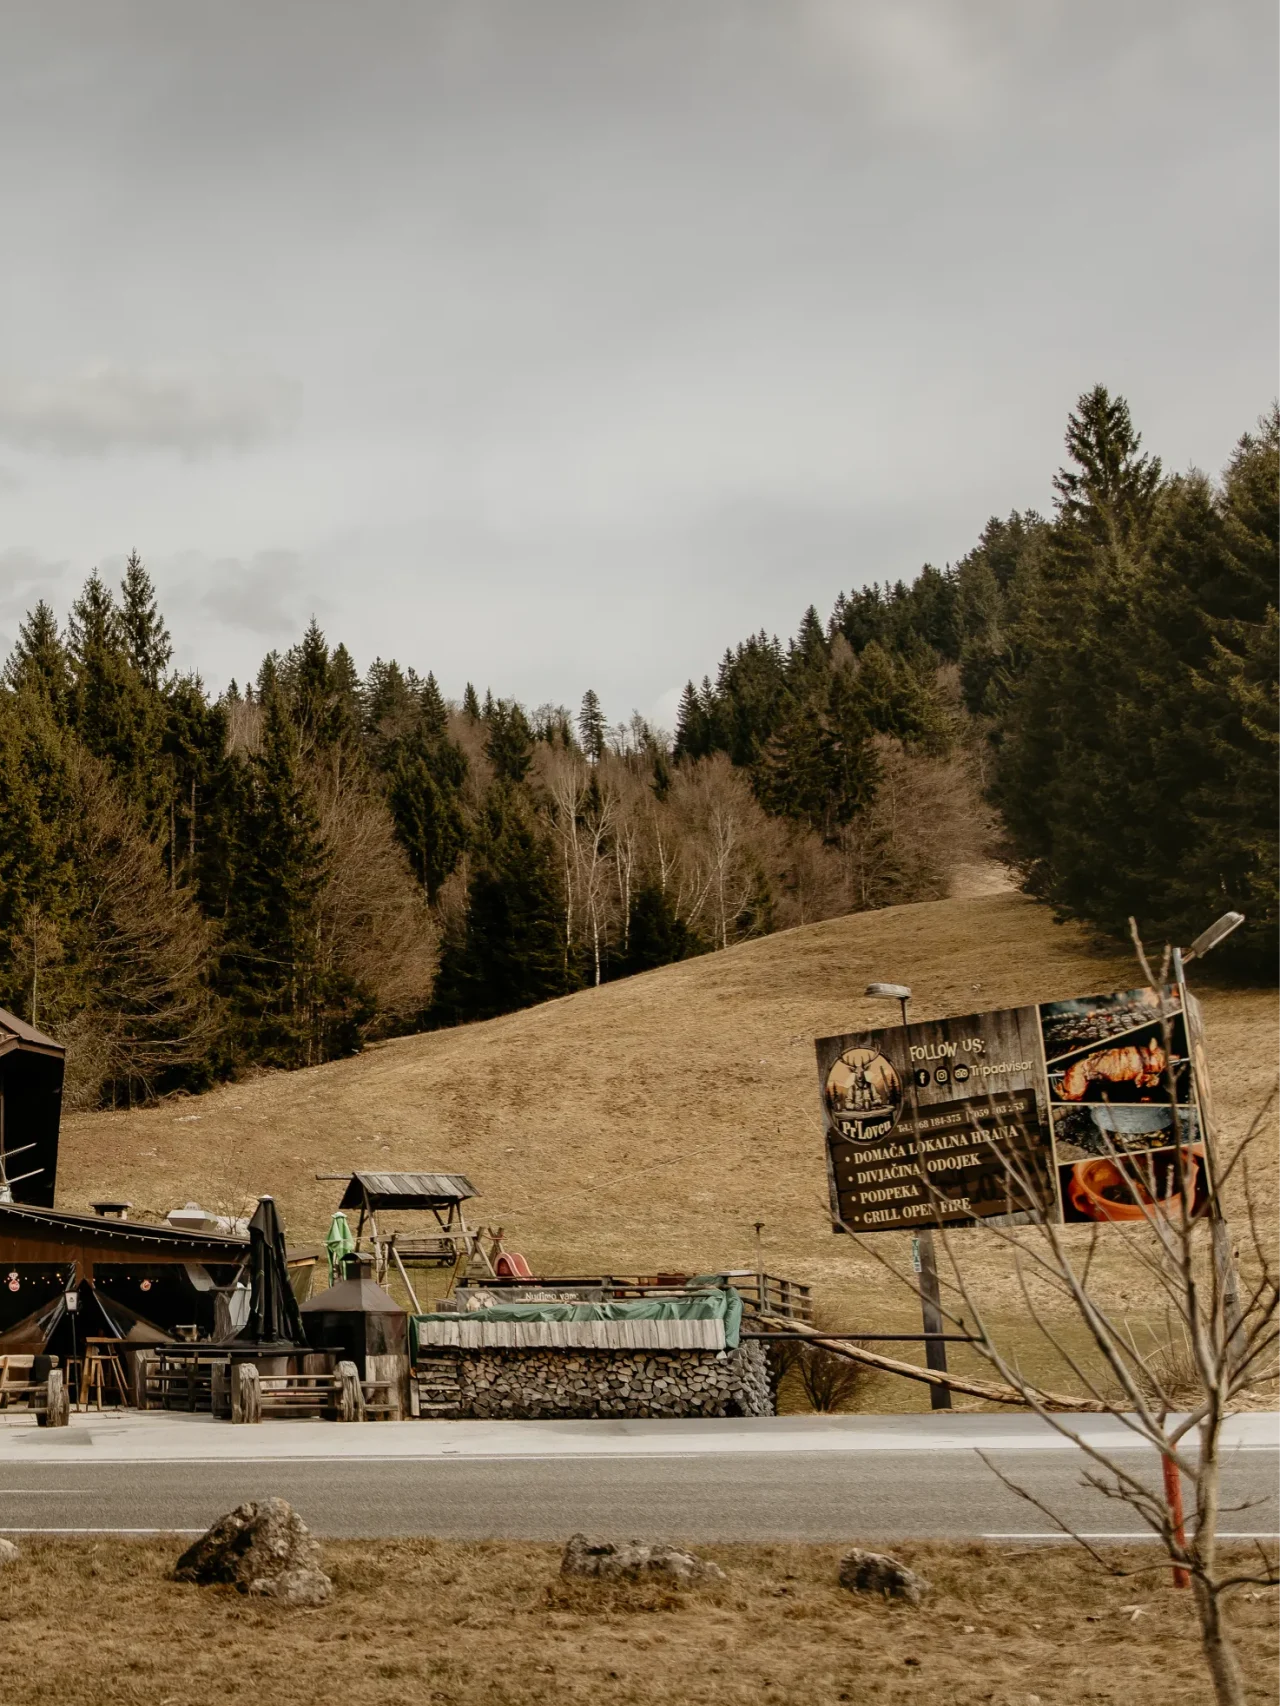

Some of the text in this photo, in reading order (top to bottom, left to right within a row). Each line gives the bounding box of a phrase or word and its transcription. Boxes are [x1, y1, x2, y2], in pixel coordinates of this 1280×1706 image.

[909, 1038, 986, 1061] FOLLOW US:
[970, 1060, 1033, 1077] Tripadvisor
[914, 1119, 929, 1130] 68
[930, 1113, 962, 1127] 184-375
[854, 1125, 1019, 1164] DOMAČA LOKALNA HRANA
[927, 1153, 982, 1172] ODOJEK
[860, 1184, 919, 1204] PODPEKA
[863, 1208, 900, 1224] GRILL
